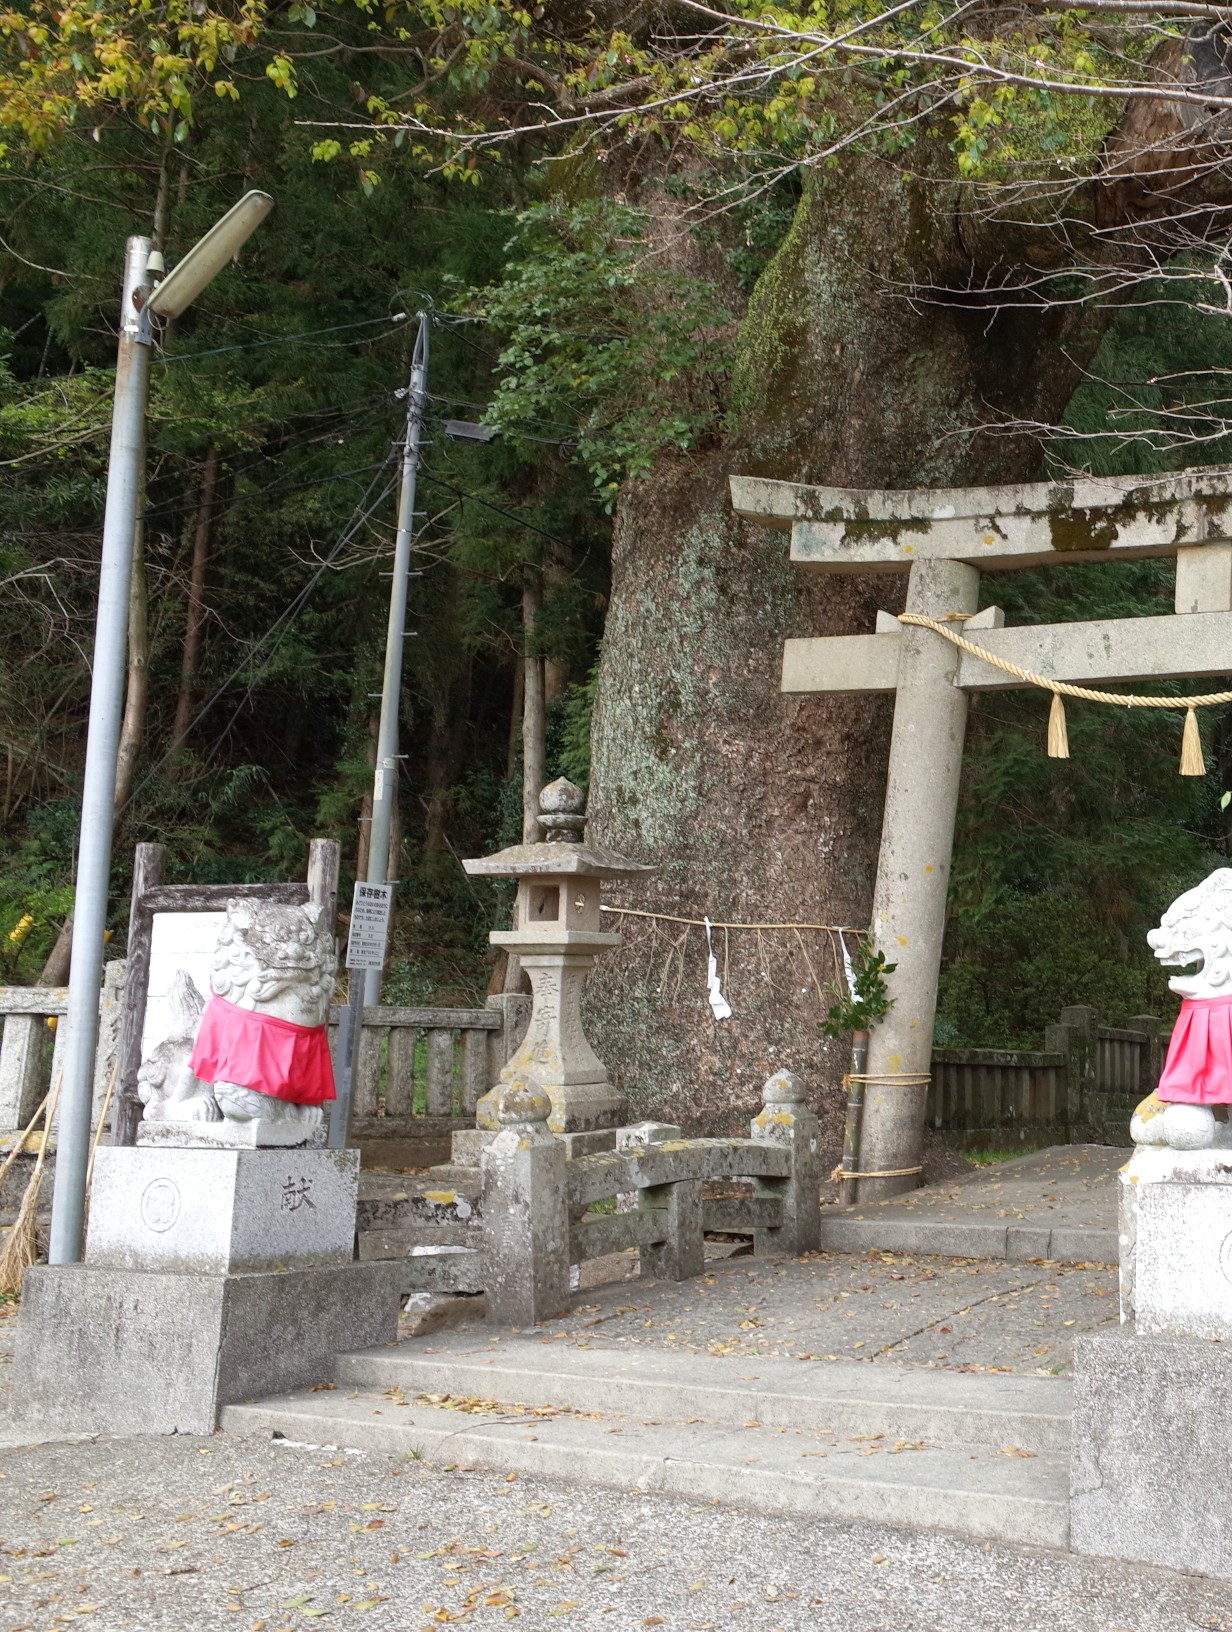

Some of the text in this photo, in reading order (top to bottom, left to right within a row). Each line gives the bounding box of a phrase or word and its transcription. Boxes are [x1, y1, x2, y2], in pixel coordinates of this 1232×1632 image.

[360, 887, 387, 899] 保存樹木
[280, 1176, 317, 1211] 献
